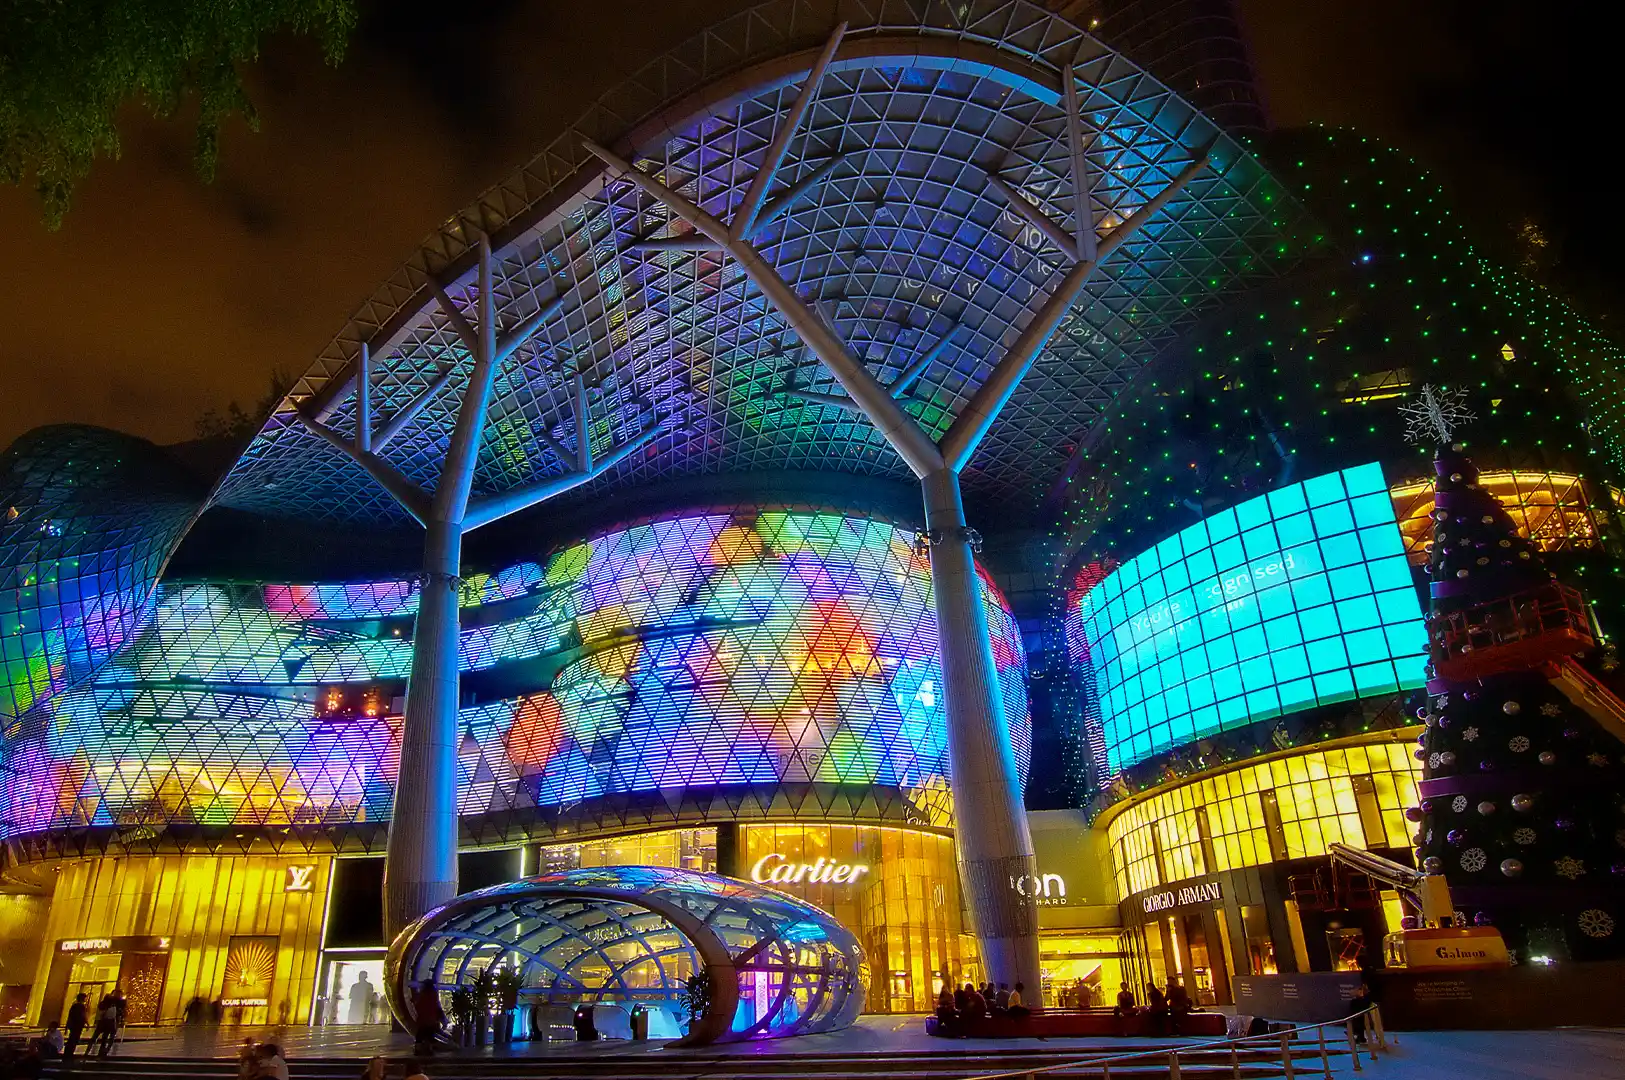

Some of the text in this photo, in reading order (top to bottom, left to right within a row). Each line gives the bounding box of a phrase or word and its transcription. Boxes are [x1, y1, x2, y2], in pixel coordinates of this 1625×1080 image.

[751, 853, 869, 884] Cartier
[1143, 882, 1221, 913] GIORGIO ARMANI
[1435, 946, 1486, 960] Galmon
